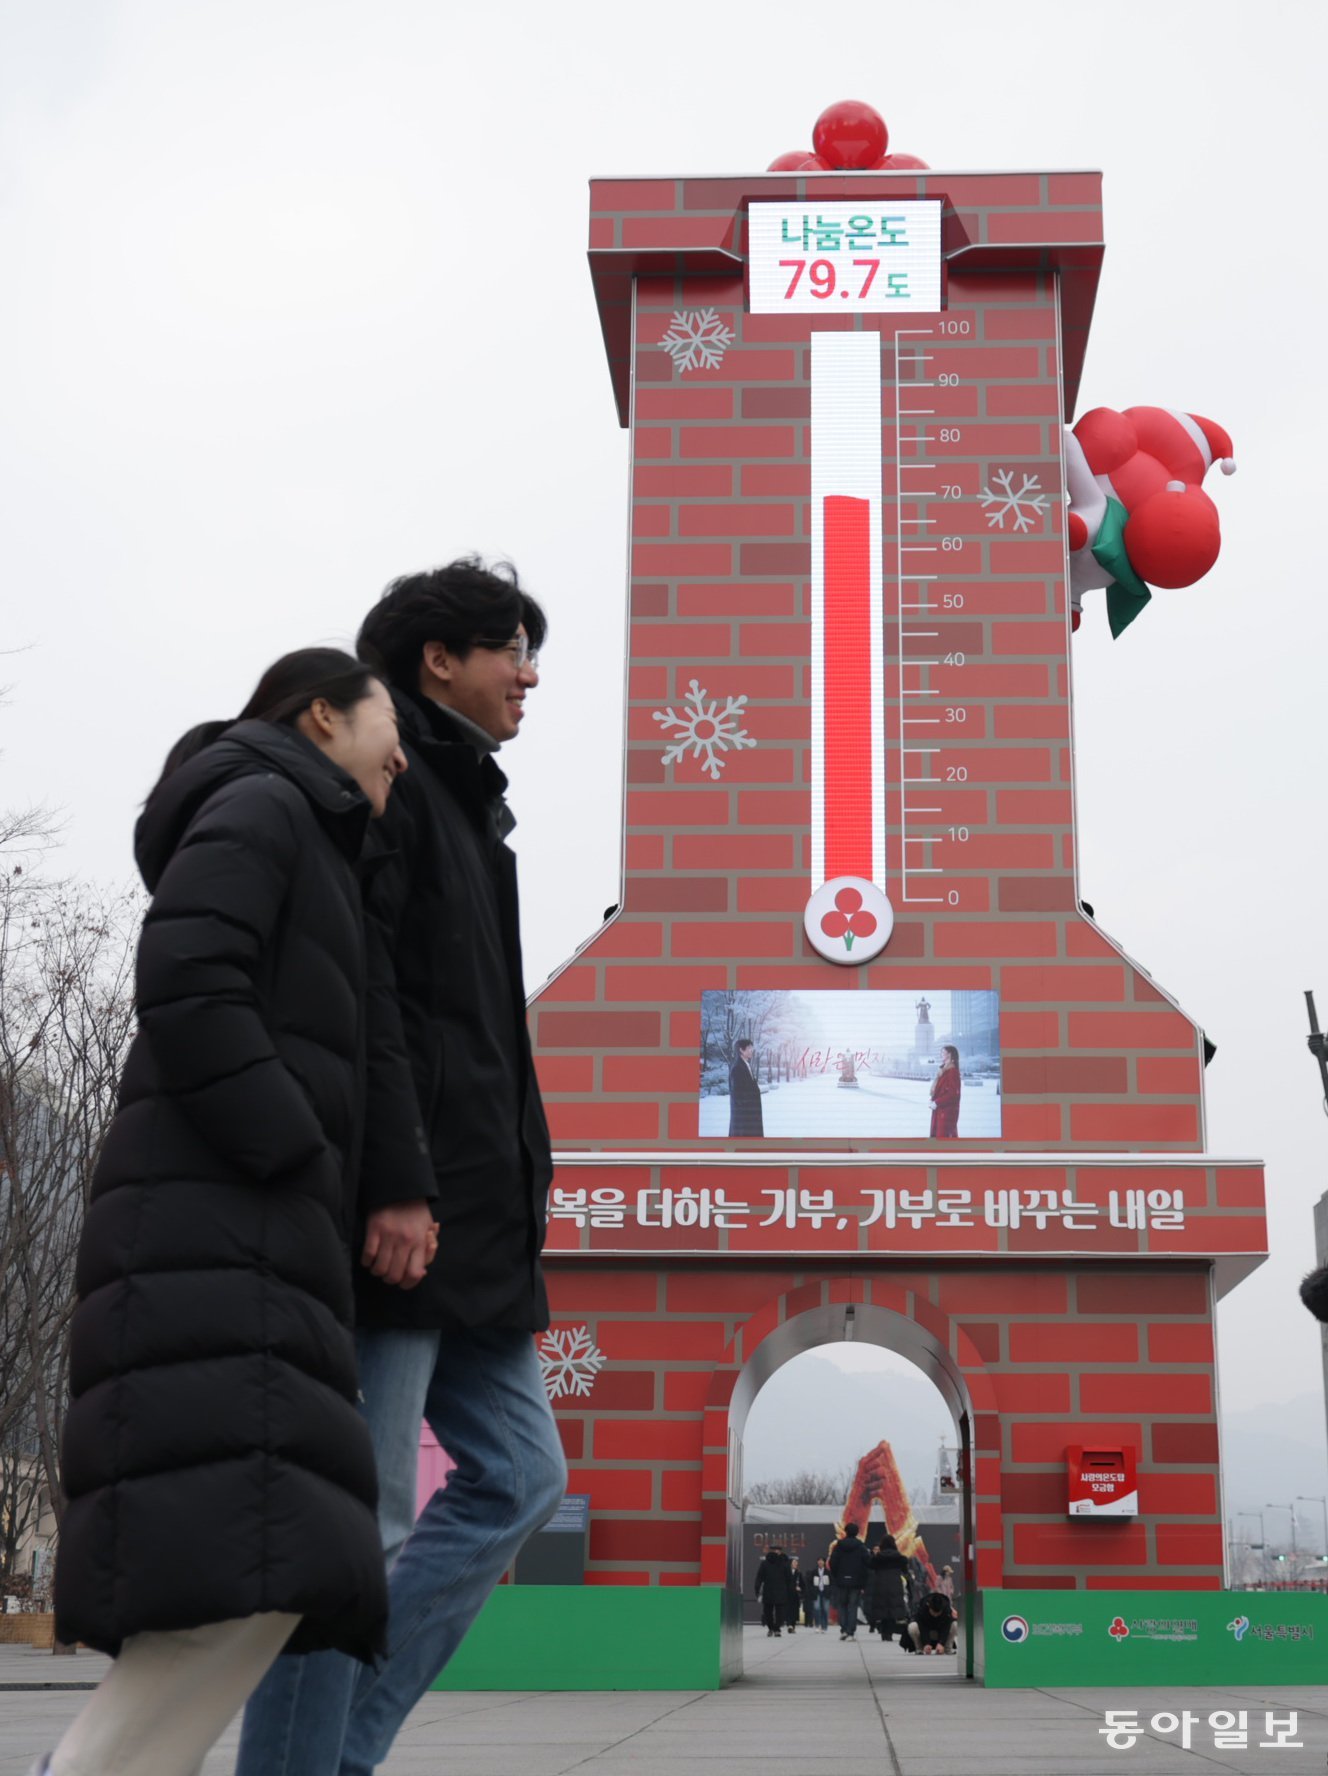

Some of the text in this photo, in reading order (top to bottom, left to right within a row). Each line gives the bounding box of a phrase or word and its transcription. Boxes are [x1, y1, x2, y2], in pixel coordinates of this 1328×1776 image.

[782, 215, 910, 251] 나눔온도
[938, 320, 970, 335] 100
[938, 373, 960, 387] 90
[939, 428, 961, 442] 80
[940, 485, 962, 500] 70
[941, 536, 963, 551] 60
[942, 593, 964, 609] 50
[943, 652, 965, 667] 40
[944, 707, 966, 723] 30
[945, 766, 968, 782] 20
[948, 826, 969, 842] 10
[947, 889, 960, 906] 0
[545, 1187, 1185, 1230] 복을 더하는 기부, 기부로 바꾸는 내일
